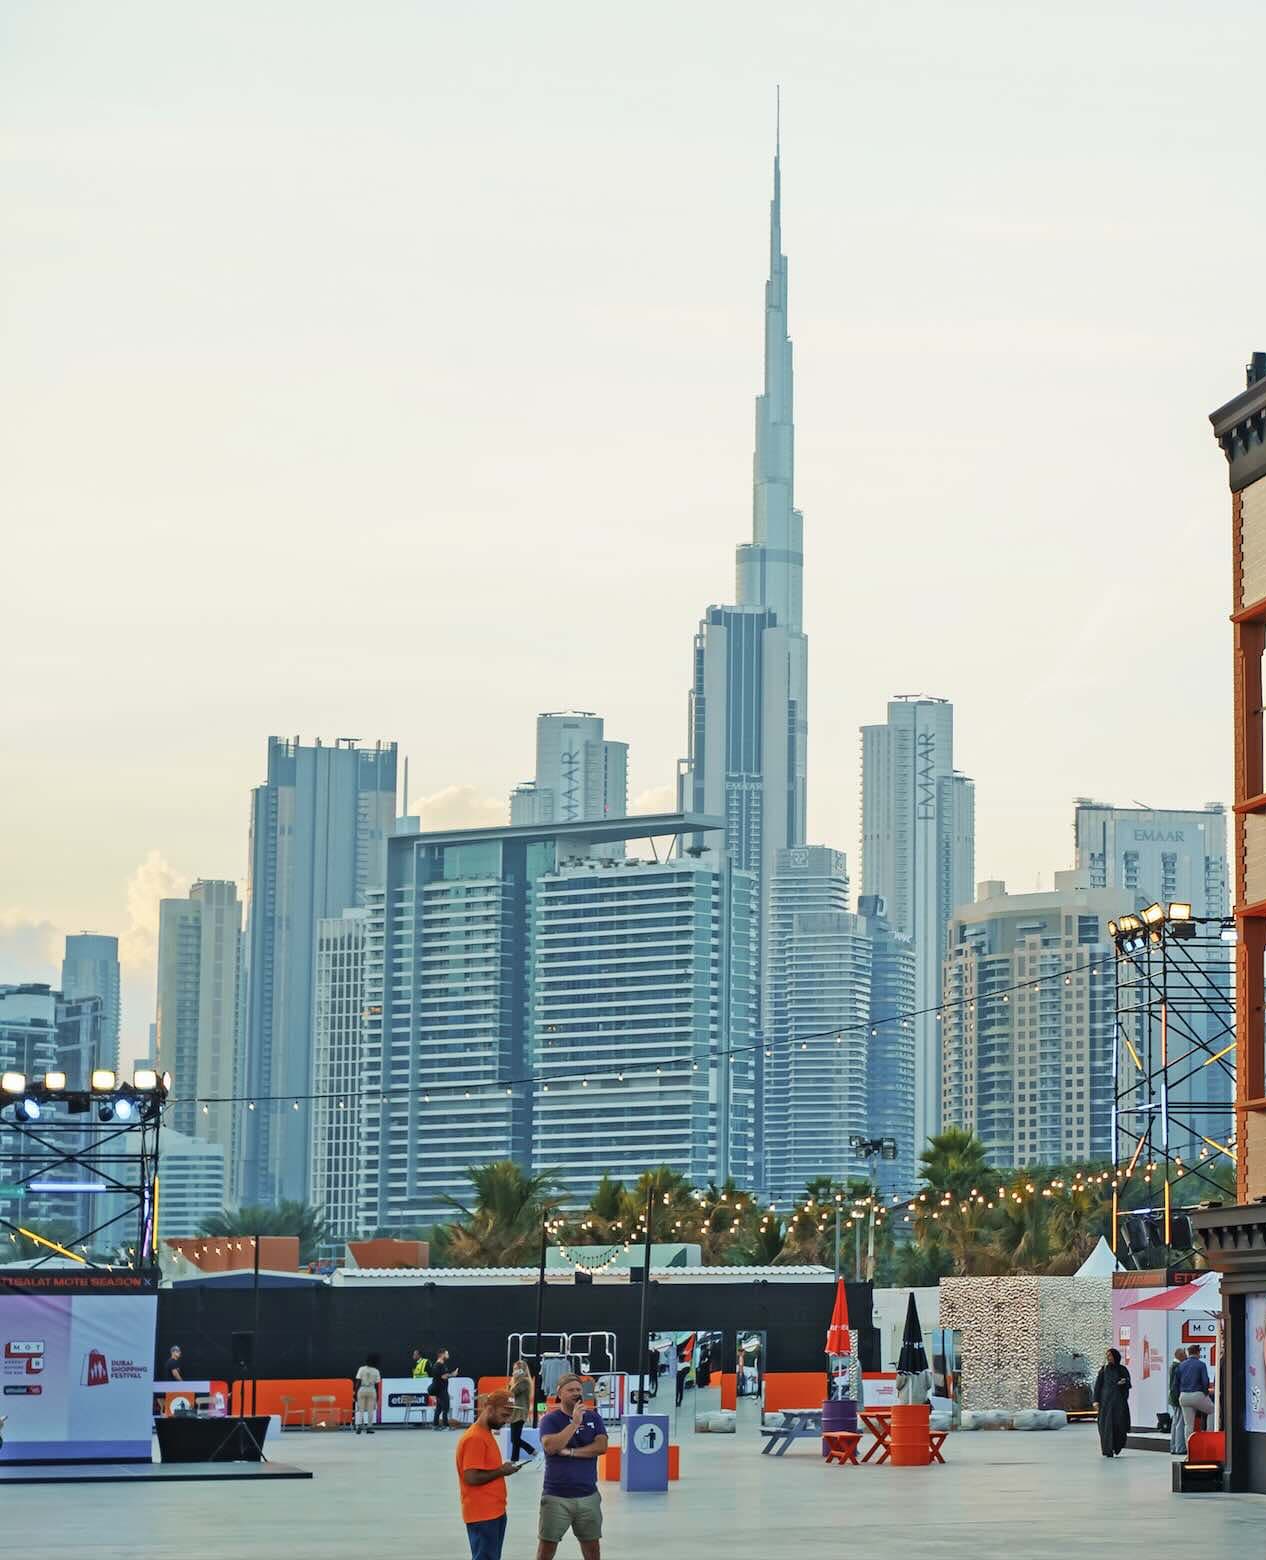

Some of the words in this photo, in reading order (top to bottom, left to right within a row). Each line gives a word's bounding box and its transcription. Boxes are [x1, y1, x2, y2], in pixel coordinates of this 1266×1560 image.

[1134, 829, 1185, 842] EMAAR
[0, 1277, 51, 1287] TISALAT
[90, 1277, 142, 1288] SEASON
[1193, 1324, 1215, 1332] MO
